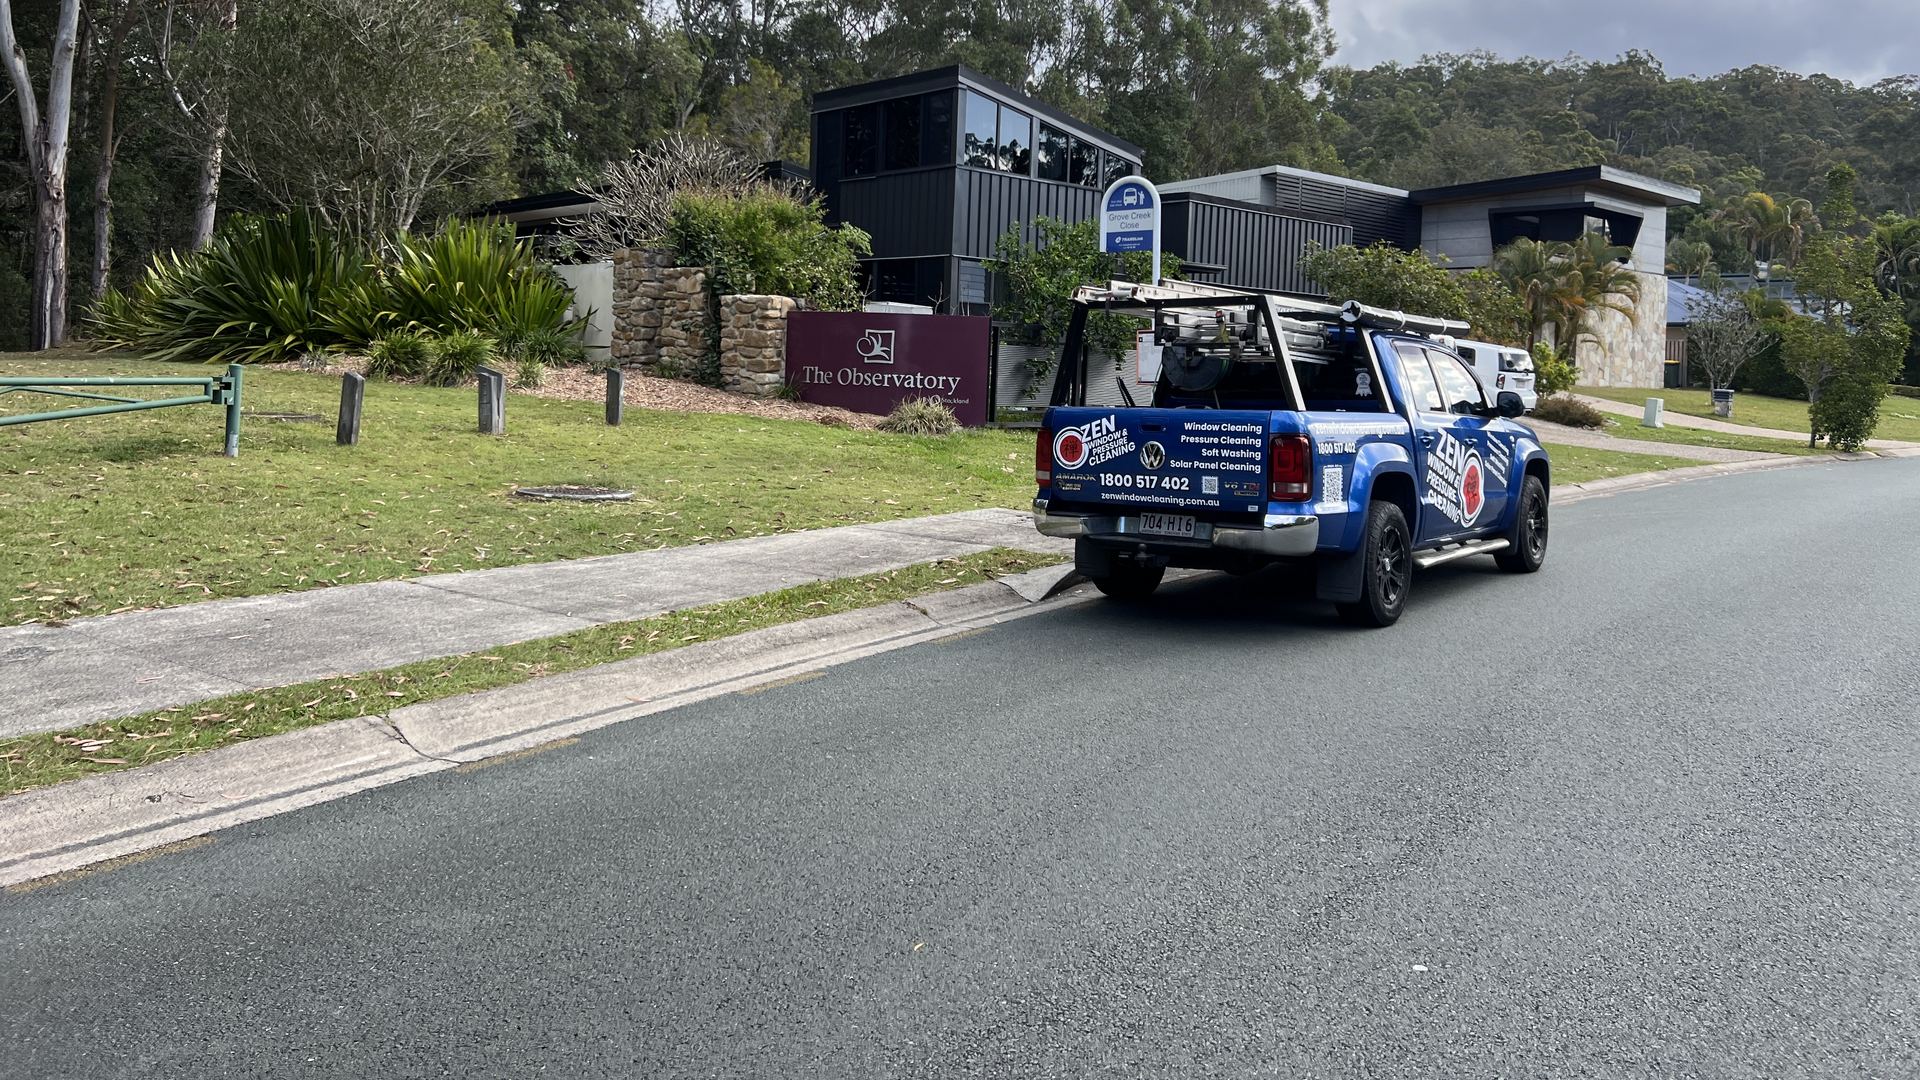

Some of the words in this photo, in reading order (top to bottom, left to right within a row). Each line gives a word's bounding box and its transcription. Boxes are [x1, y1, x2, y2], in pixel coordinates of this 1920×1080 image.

[1109, 213, 1129, 221] Grove
[1131, 211, 1151, 220] Creek
[1120, 221, 1140, 230] Close
[802, 366, 833, 384] The
[837, 368, 961, 395] Observatory
[1080, 414, 1116, 442] ZEN
[1184, 422, 1220, 431] Window
[1221, 423, 1262, 435] Cleaning
[1087, 430, 1121, 449] WINDOW
[1122, 428, 1128, 437] &
[1092, 436, 1128, 456] PRESSURE
[1181, 435, 1219, 444] Pressure
[1220, 436, 1262, 448] Cleaning
[1089, 442, 1136, 466] CLEANING
[1201, 448, 1219, 457] Soft
[1220, 449, 1261, 460] Washing
[1317, 443, 1333, 454] 1800
[1334, 442, 1344, 454] 517
[1344, 442, 1356, 454] 402
[1436, 427, 1465, 475] ZEN
[1170, 460, 1192, 468] Solar
[1193, 461, 1219, 470] Panel
[1220, 462, 1261, 474] Cleaning
[1427, 451, 1456, 484] WINDOW
[1099, 473, 1132, 487] 1800
[1136, 475, 1158, 489] 517
[1161, 476, 1190, 491] 402
[1426, 469, 1458, 502] PRESSURE
[1101, 492, 1220, 507] zenwindowcleaning.com.au
[1428, 489, 1461, 523] CLEANING
[1142, 514, 1163, 530] 704
